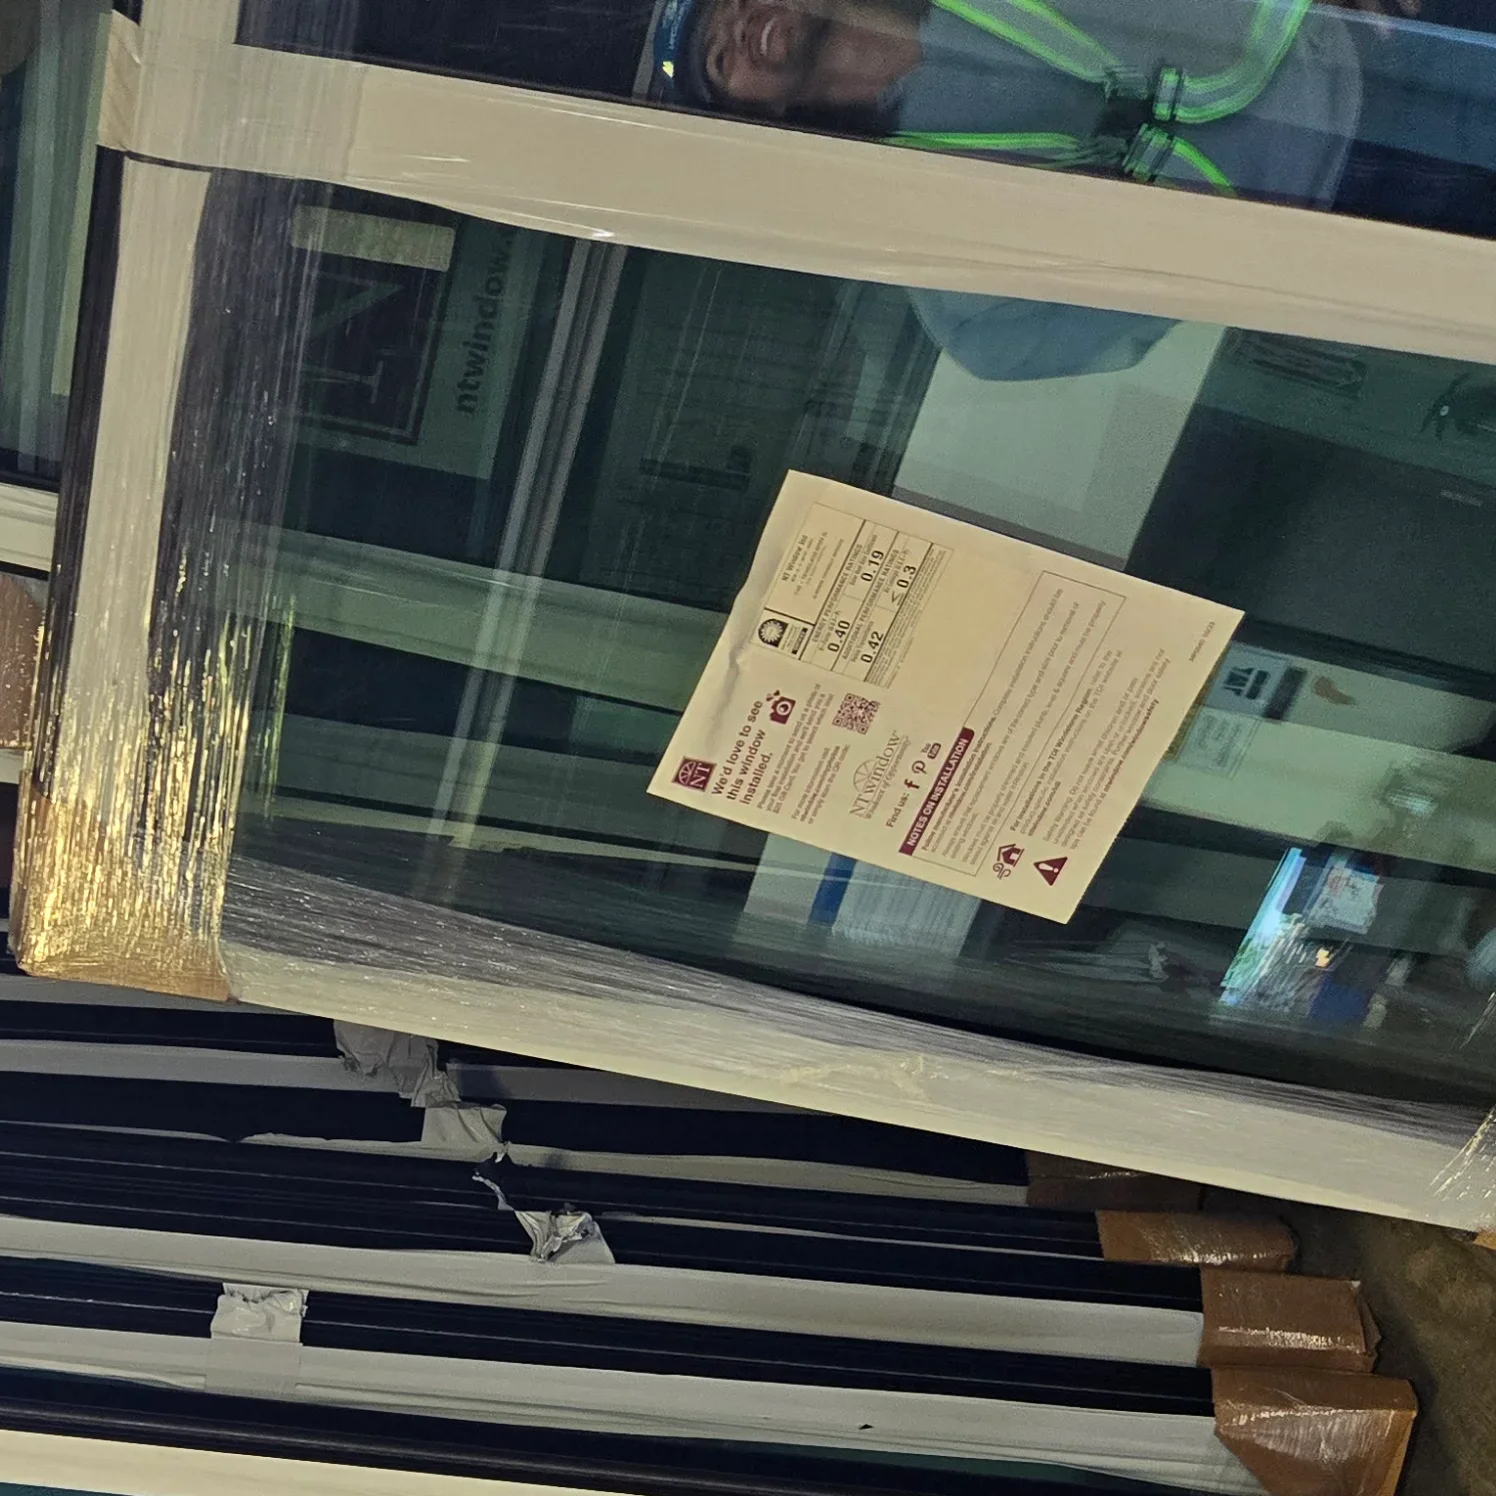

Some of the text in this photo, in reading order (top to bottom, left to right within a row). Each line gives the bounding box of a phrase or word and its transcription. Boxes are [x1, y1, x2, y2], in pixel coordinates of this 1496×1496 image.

[859, 548, 885, 582] 0.19
[895, 564, 917, 588] 0.3
[811, 543, 863, 642] ENERGY PERFORMANCE RATINGS
[825, 619, 851, 652] 0.40
[859, 630, 885, 663] 0.42
[711, 699, 764, 796] We'd love to see
[725, 728, 767, 800] this window
[689, 762, 712, 788] NT
[739, 750, 773, 804] installed.
[848, 732, 901, 817] NTwindow
[905, 737, 969, 846] NOTES ON INSTALLATION
[884, 806, 902, 827] Find
[895, 791, 910, 807] us:
